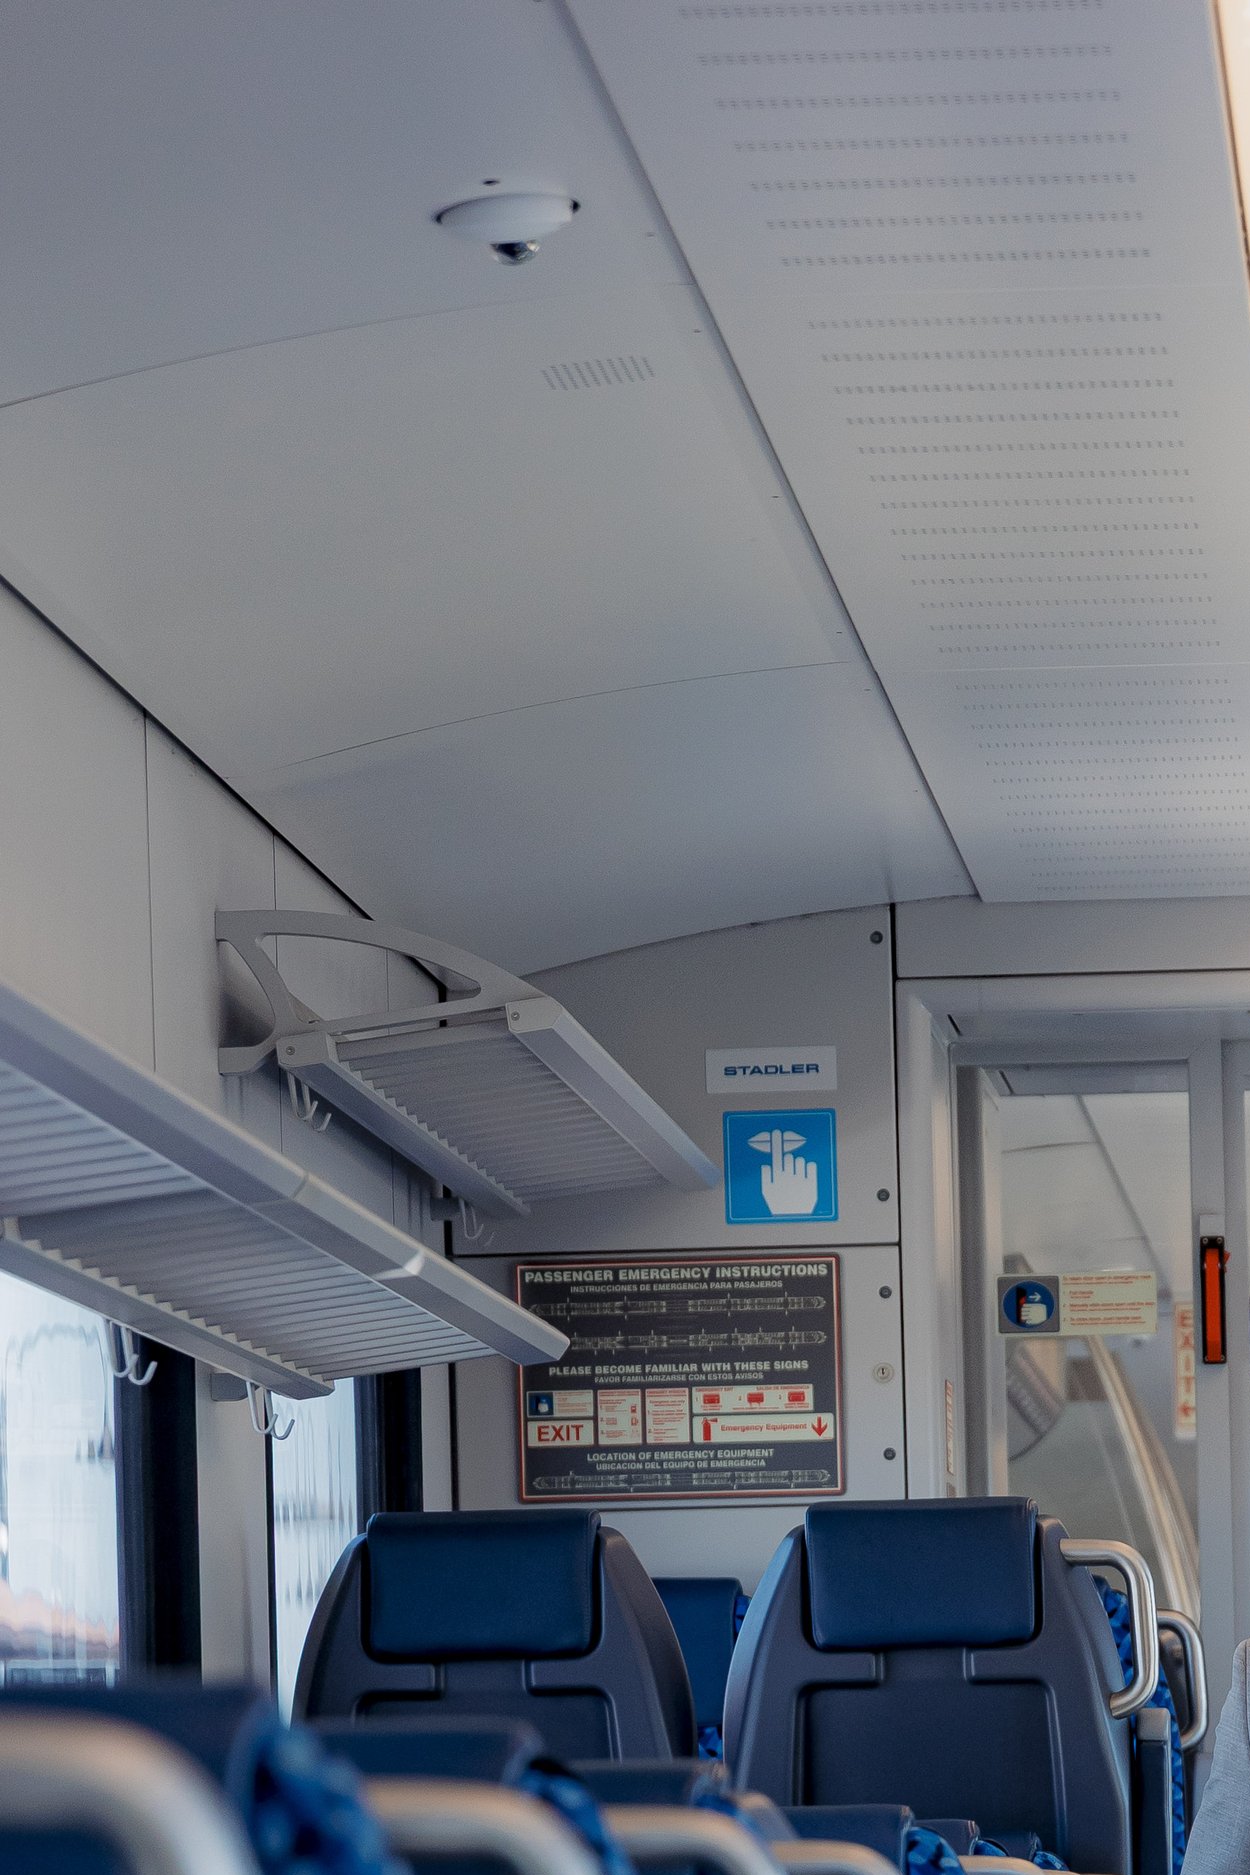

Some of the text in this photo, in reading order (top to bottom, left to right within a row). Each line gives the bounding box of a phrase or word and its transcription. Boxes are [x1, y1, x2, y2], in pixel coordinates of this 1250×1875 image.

[723, 1063, 820, 1076] STADLER
[524, 1263, 828, 1283] PASSENGER EMERGENCY INSTRUCTIONS
[570, 1280, 783, 1293] INSTRUCCIONES DE EMERGENCIA PARA PASAJEROS
[549, 1360, 809, 1376] PLEASE BECOME FAMILIAR WITH THESE SIGNS
[621, 1374, 686, 1382] FAMILIARIZARSE
[688, 1373, 706, 1381] CON
[536, 1424, 584, 1442] EXIT
[720, 1423, 807, 1432] Emergency Equipment
[587, 1448, 774, 1462] LOCATION OF EMERGENCY EQUIPMENT
[596, 1459, 766, 1470] UBICACION DEL EQUIPO DE EMERGENCIA
